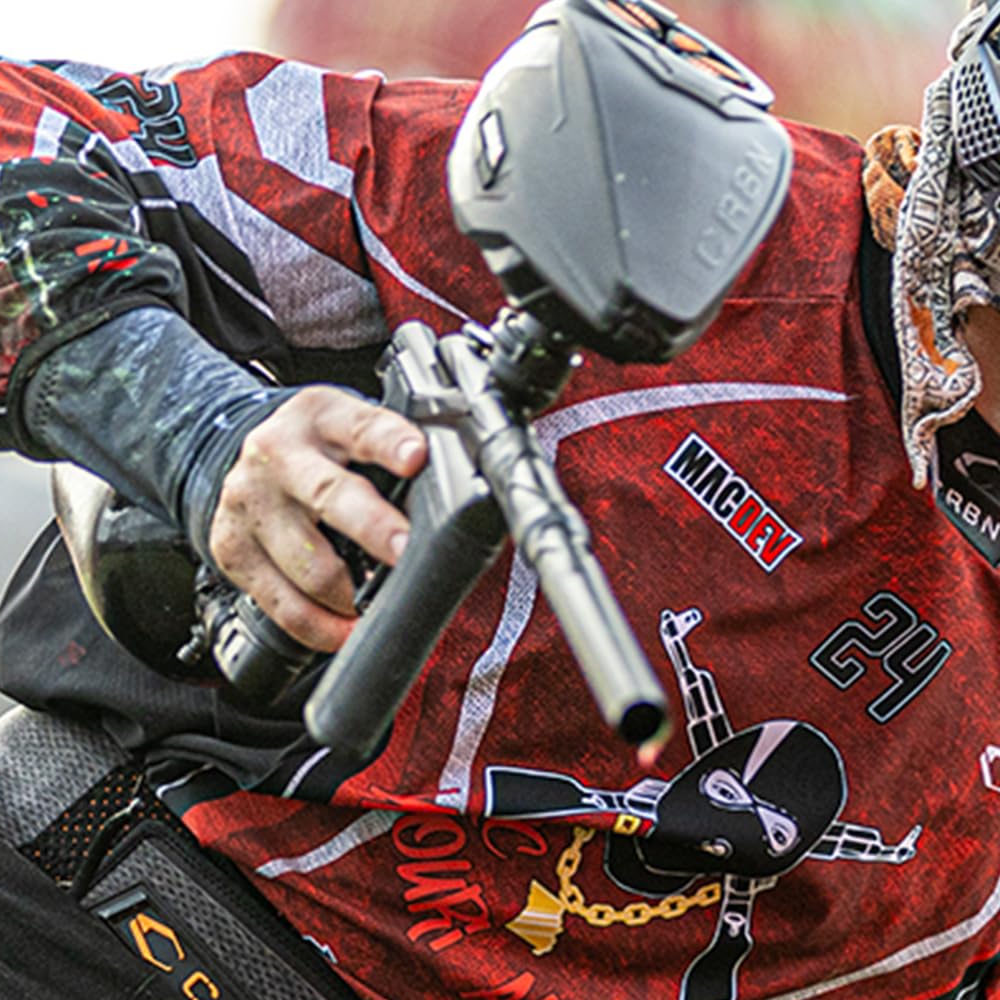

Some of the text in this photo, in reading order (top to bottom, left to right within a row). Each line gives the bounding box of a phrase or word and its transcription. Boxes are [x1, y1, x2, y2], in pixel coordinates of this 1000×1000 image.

[92, 78, 197, 167] 24
[697, 140, 773, 267] CRBN
[669, 437, 798, 565] MACDEV
[937, 480, 1000, 541] RBN
[809, 591, 954, 723] 24
[391, 813, 491, 952] OURI
